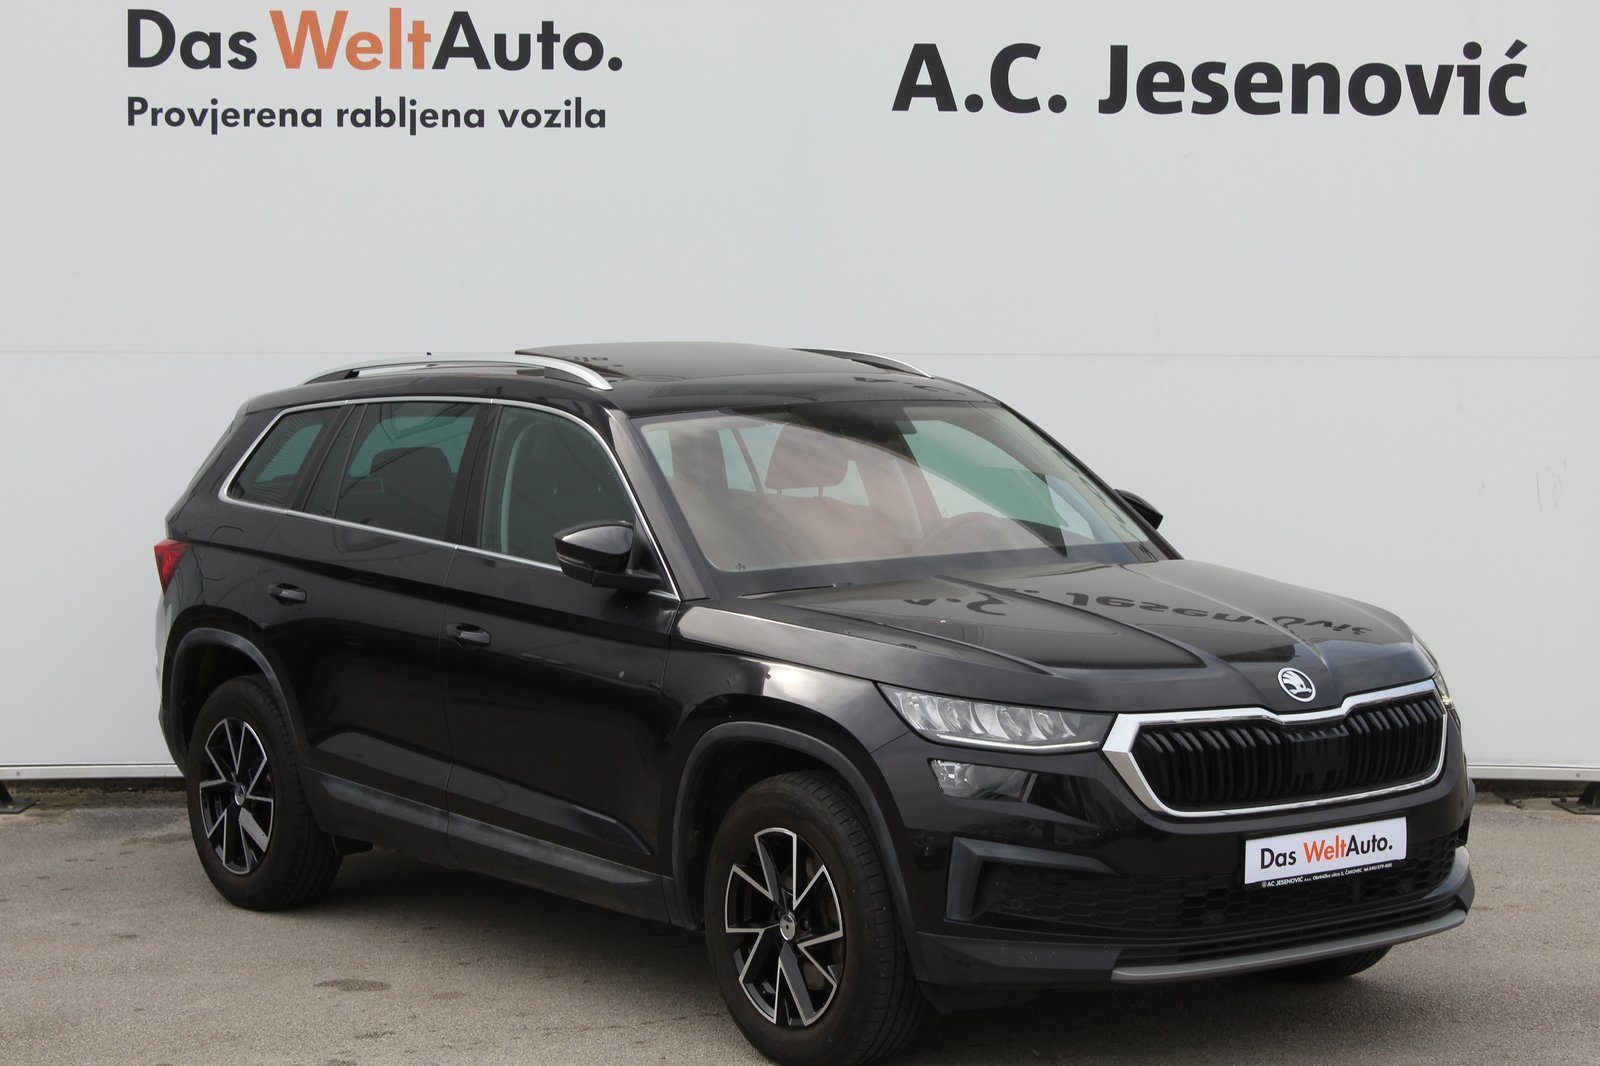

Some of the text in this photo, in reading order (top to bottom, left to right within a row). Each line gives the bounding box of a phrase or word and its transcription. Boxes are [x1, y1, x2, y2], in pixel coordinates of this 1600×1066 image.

[128, 7, 623, 72] Das WeltAuto.
[892, 38, 1529, 117] A.C. Jesenović
[128, 95, 606, 136] Provjerena rabljena vozila
[1260, 834, 1394, 870] Das WeltAuto.
